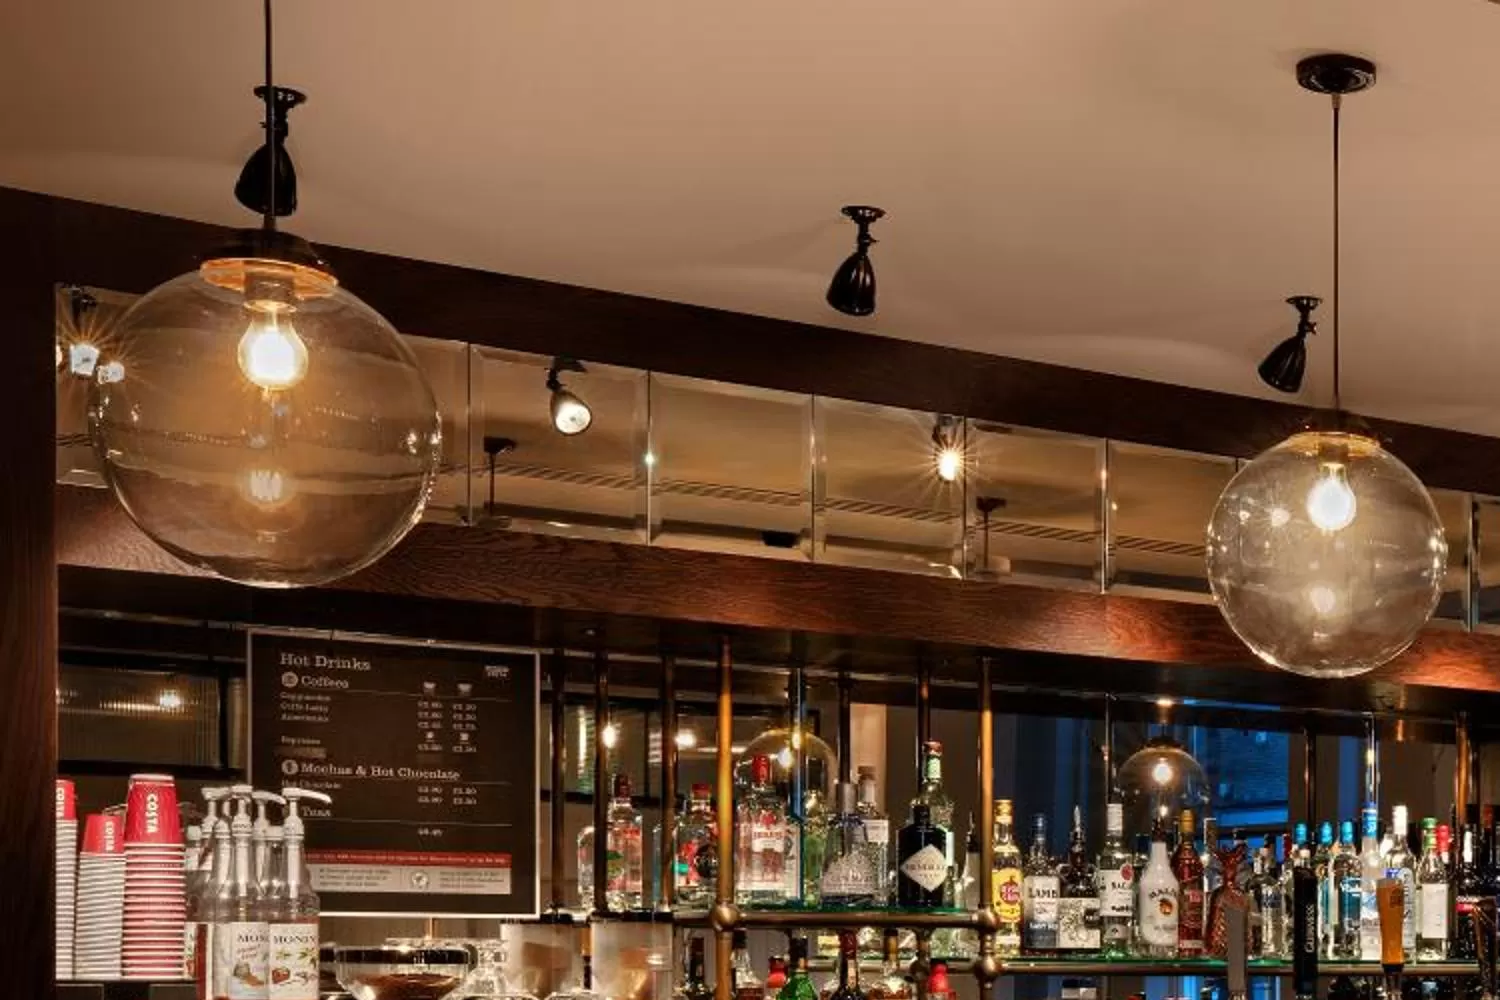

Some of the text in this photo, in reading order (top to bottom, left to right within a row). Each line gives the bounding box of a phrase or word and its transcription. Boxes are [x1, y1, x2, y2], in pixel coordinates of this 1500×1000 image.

[281, 653, 371, 671] Hot Drinks
[356, 765, 367, 776] &
[370, 765, 395, 777] Hot
[397, 767, 460, 780] Chocolate
[145, 793, 159, 833] COSTA
